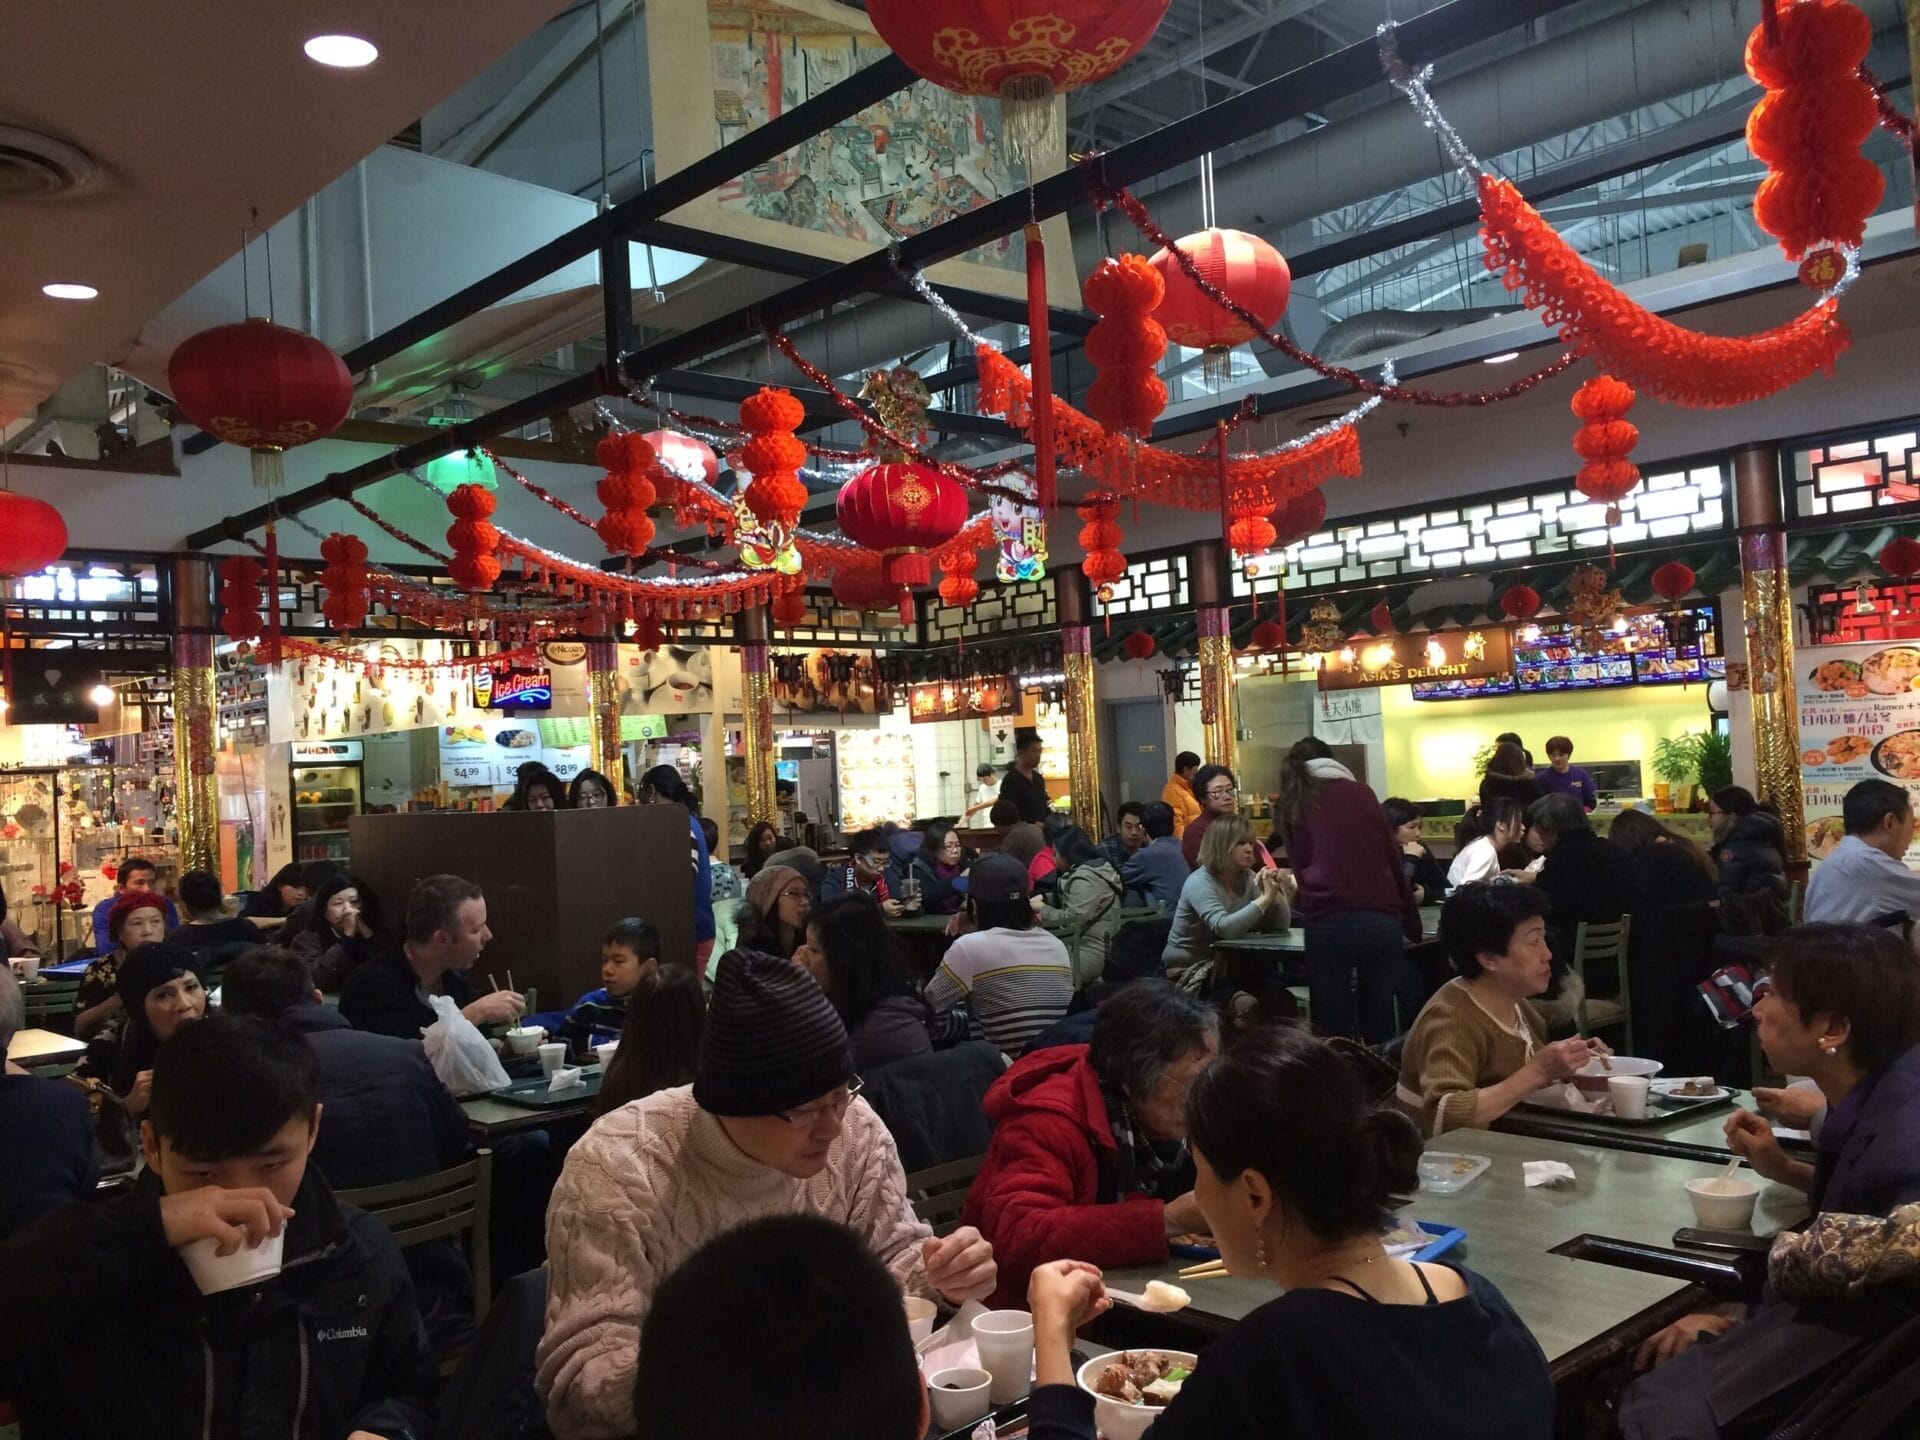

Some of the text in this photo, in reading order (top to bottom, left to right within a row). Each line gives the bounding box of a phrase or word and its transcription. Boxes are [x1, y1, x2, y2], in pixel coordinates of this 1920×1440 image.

[1807, 255, 1835, 284] 福
[1358, 664, 1468, 683] ASIA'S DELIGHT
[495, 674, 549, 699] Ice Cream
[1874, 703, 1905, 711] Ramen
[454, 768, 480, 779] $4.99
[555, 764, 578, 775] $8.99
[326, 1326, 368, 1340] Columbia
